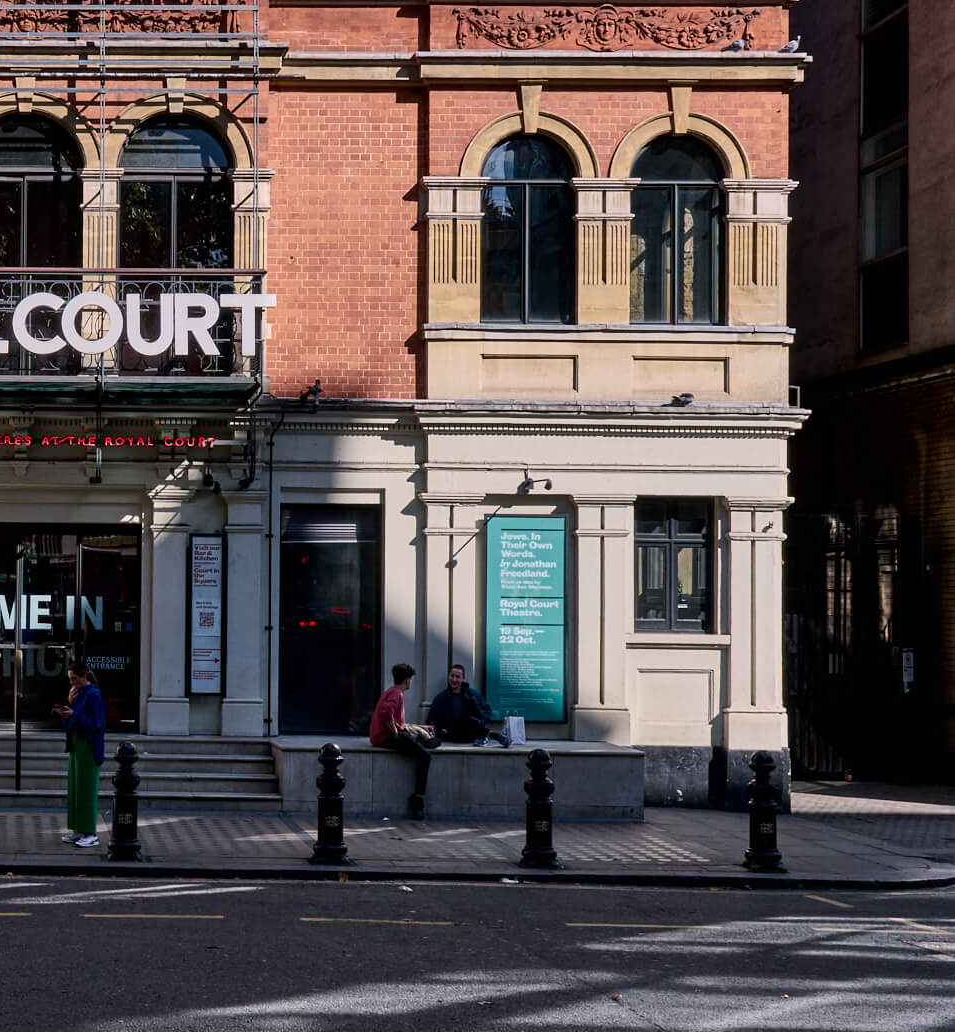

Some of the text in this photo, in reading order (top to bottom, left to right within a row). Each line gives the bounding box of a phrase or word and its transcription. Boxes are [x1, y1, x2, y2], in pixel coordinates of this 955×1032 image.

[11, 290, 278, 357] COURT
[67, 436, 97, 447] THE
[104, 436, 154, 447] ROYAL
[163, 436, 216, 448] COURT
[531, 532, 541, 541] In
[501, 541, 553, 550] Their Own
[512, 560, 557, 568] Jonathan
[500, 600, 559, 609] Royal Court
[66, 595, 104, 630] IN
[86, 656, 131, 664] ACCESSIBLE
